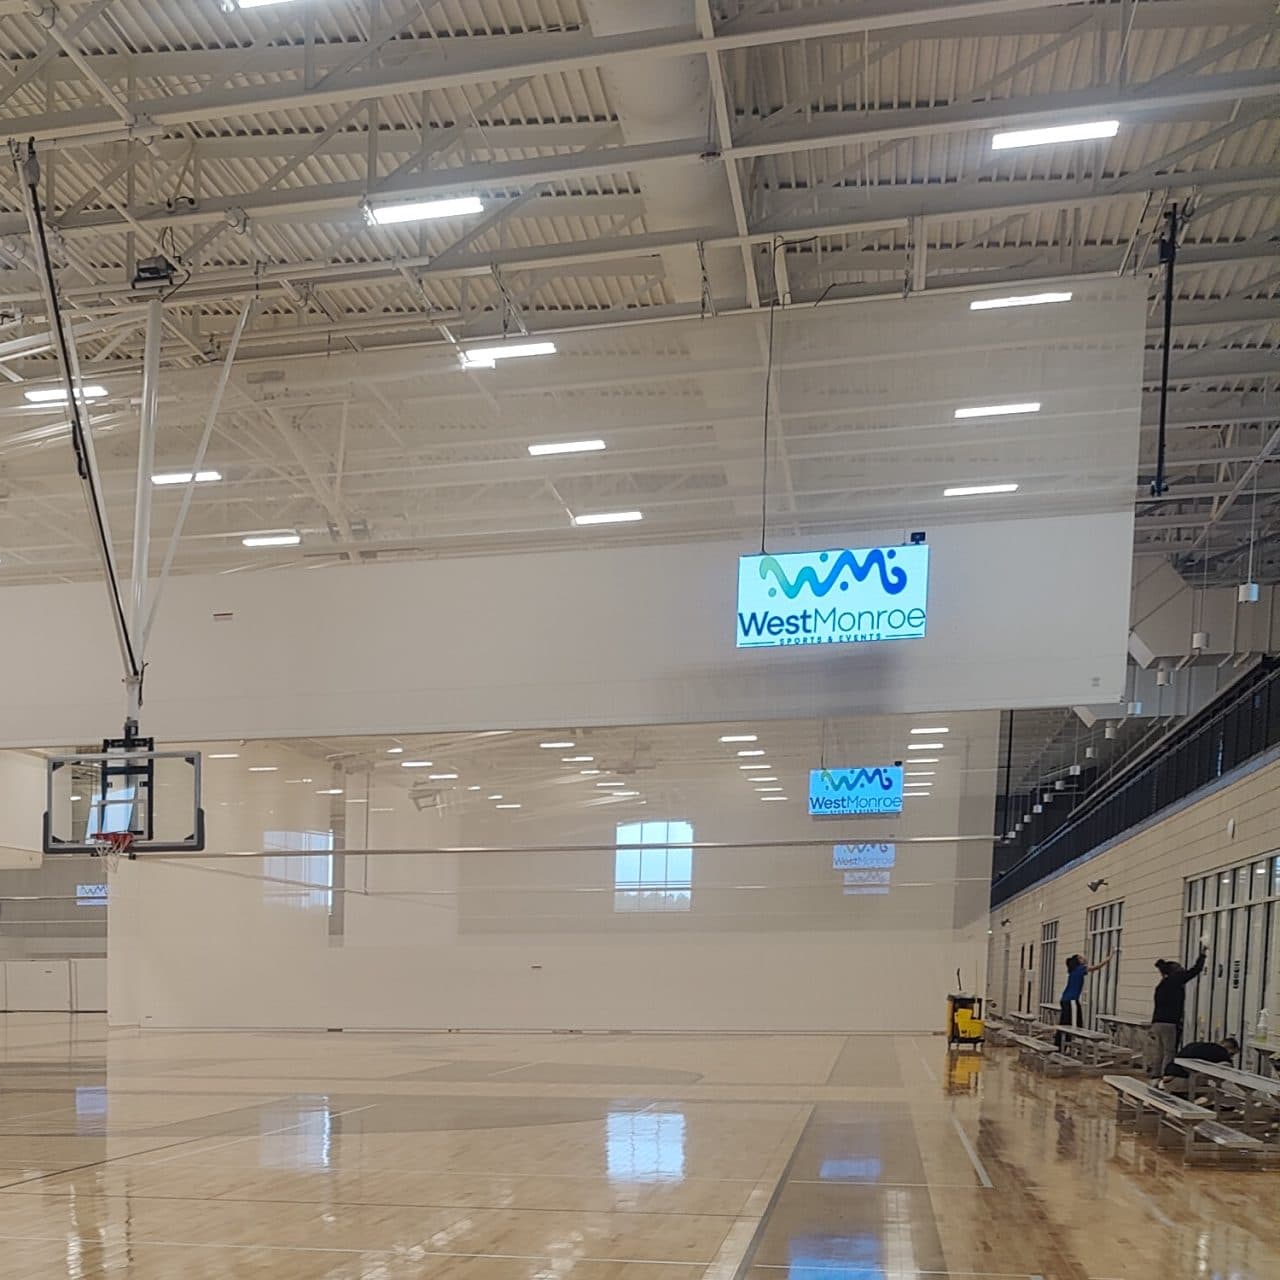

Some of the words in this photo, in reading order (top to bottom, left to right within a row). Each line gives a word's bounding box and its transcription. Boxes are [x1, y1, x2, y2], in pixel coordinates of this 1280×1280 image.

[738, 607, 926, 637] WestMonroe
[839, 633, 882, 642] EVENTS
[810, 795, 903, 809] WestMonroe
